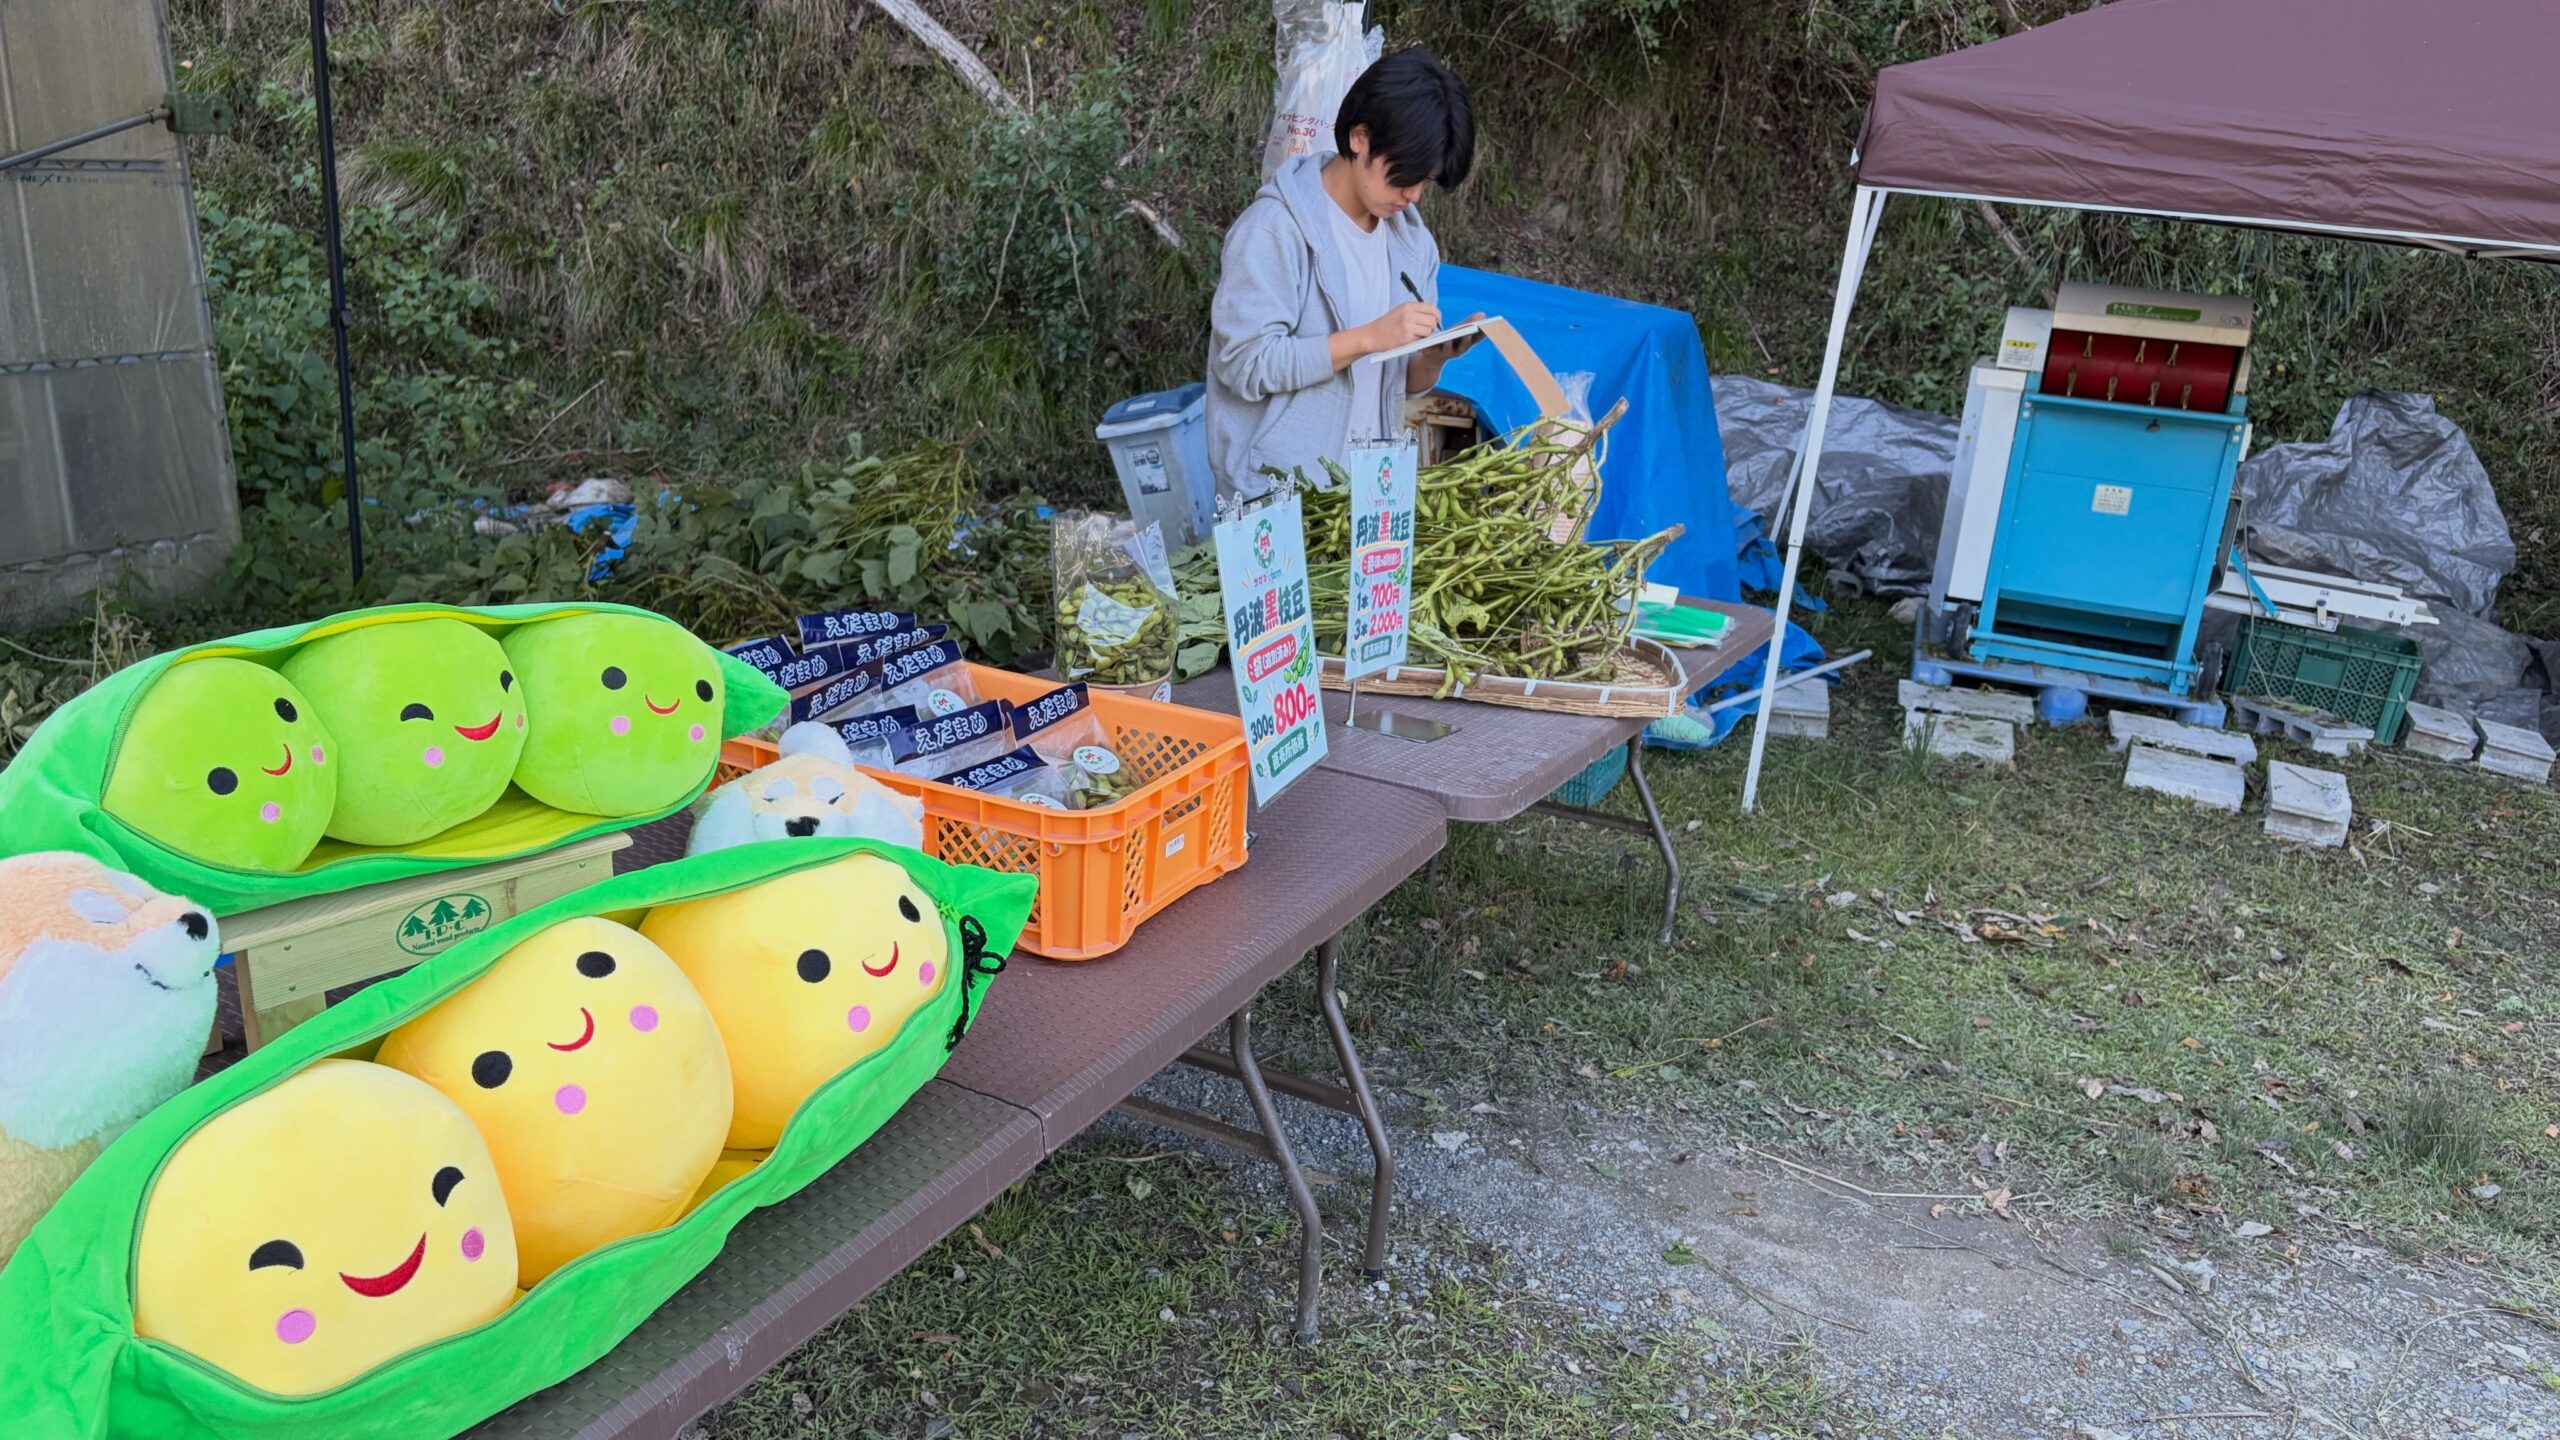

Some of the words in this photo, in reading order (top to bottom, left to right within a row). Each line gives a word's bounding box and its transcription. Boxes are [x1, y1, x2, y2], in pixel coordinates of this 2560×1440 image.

[1287, 125, 1316, 137] No.30
[1356, 511, 1411, 548] 丹波黒枝豆
[1357, 592, 1368, 611] 1本
[1372, 581, 1400, 610] 700円
[824, 611, 899, 639] えだまめ
[1234, 579, 1305, 650] 丹波黒枝豆
[1354, 619, 1368, 640] 3本
[738, 645, 782, 669] だまめ
[857, 628, 930, 666] えだまめ
[884, 645, 946, 685] えだまめ
[808, 671, 869, 719] えだまめ
[1028, 689, 1078, 730] えだまめ
[841, 715, 901, 743] だまめ
[1250, 714, 1274, 745] 300g
[1274, 682, 1316, 735] 800円
[915, 711, 987, 753] えだまめ
[953, 757, 1028, 790] えだまめ
[412, 937, 436, 952] Natural
[436, 935, 454, 946] wood
